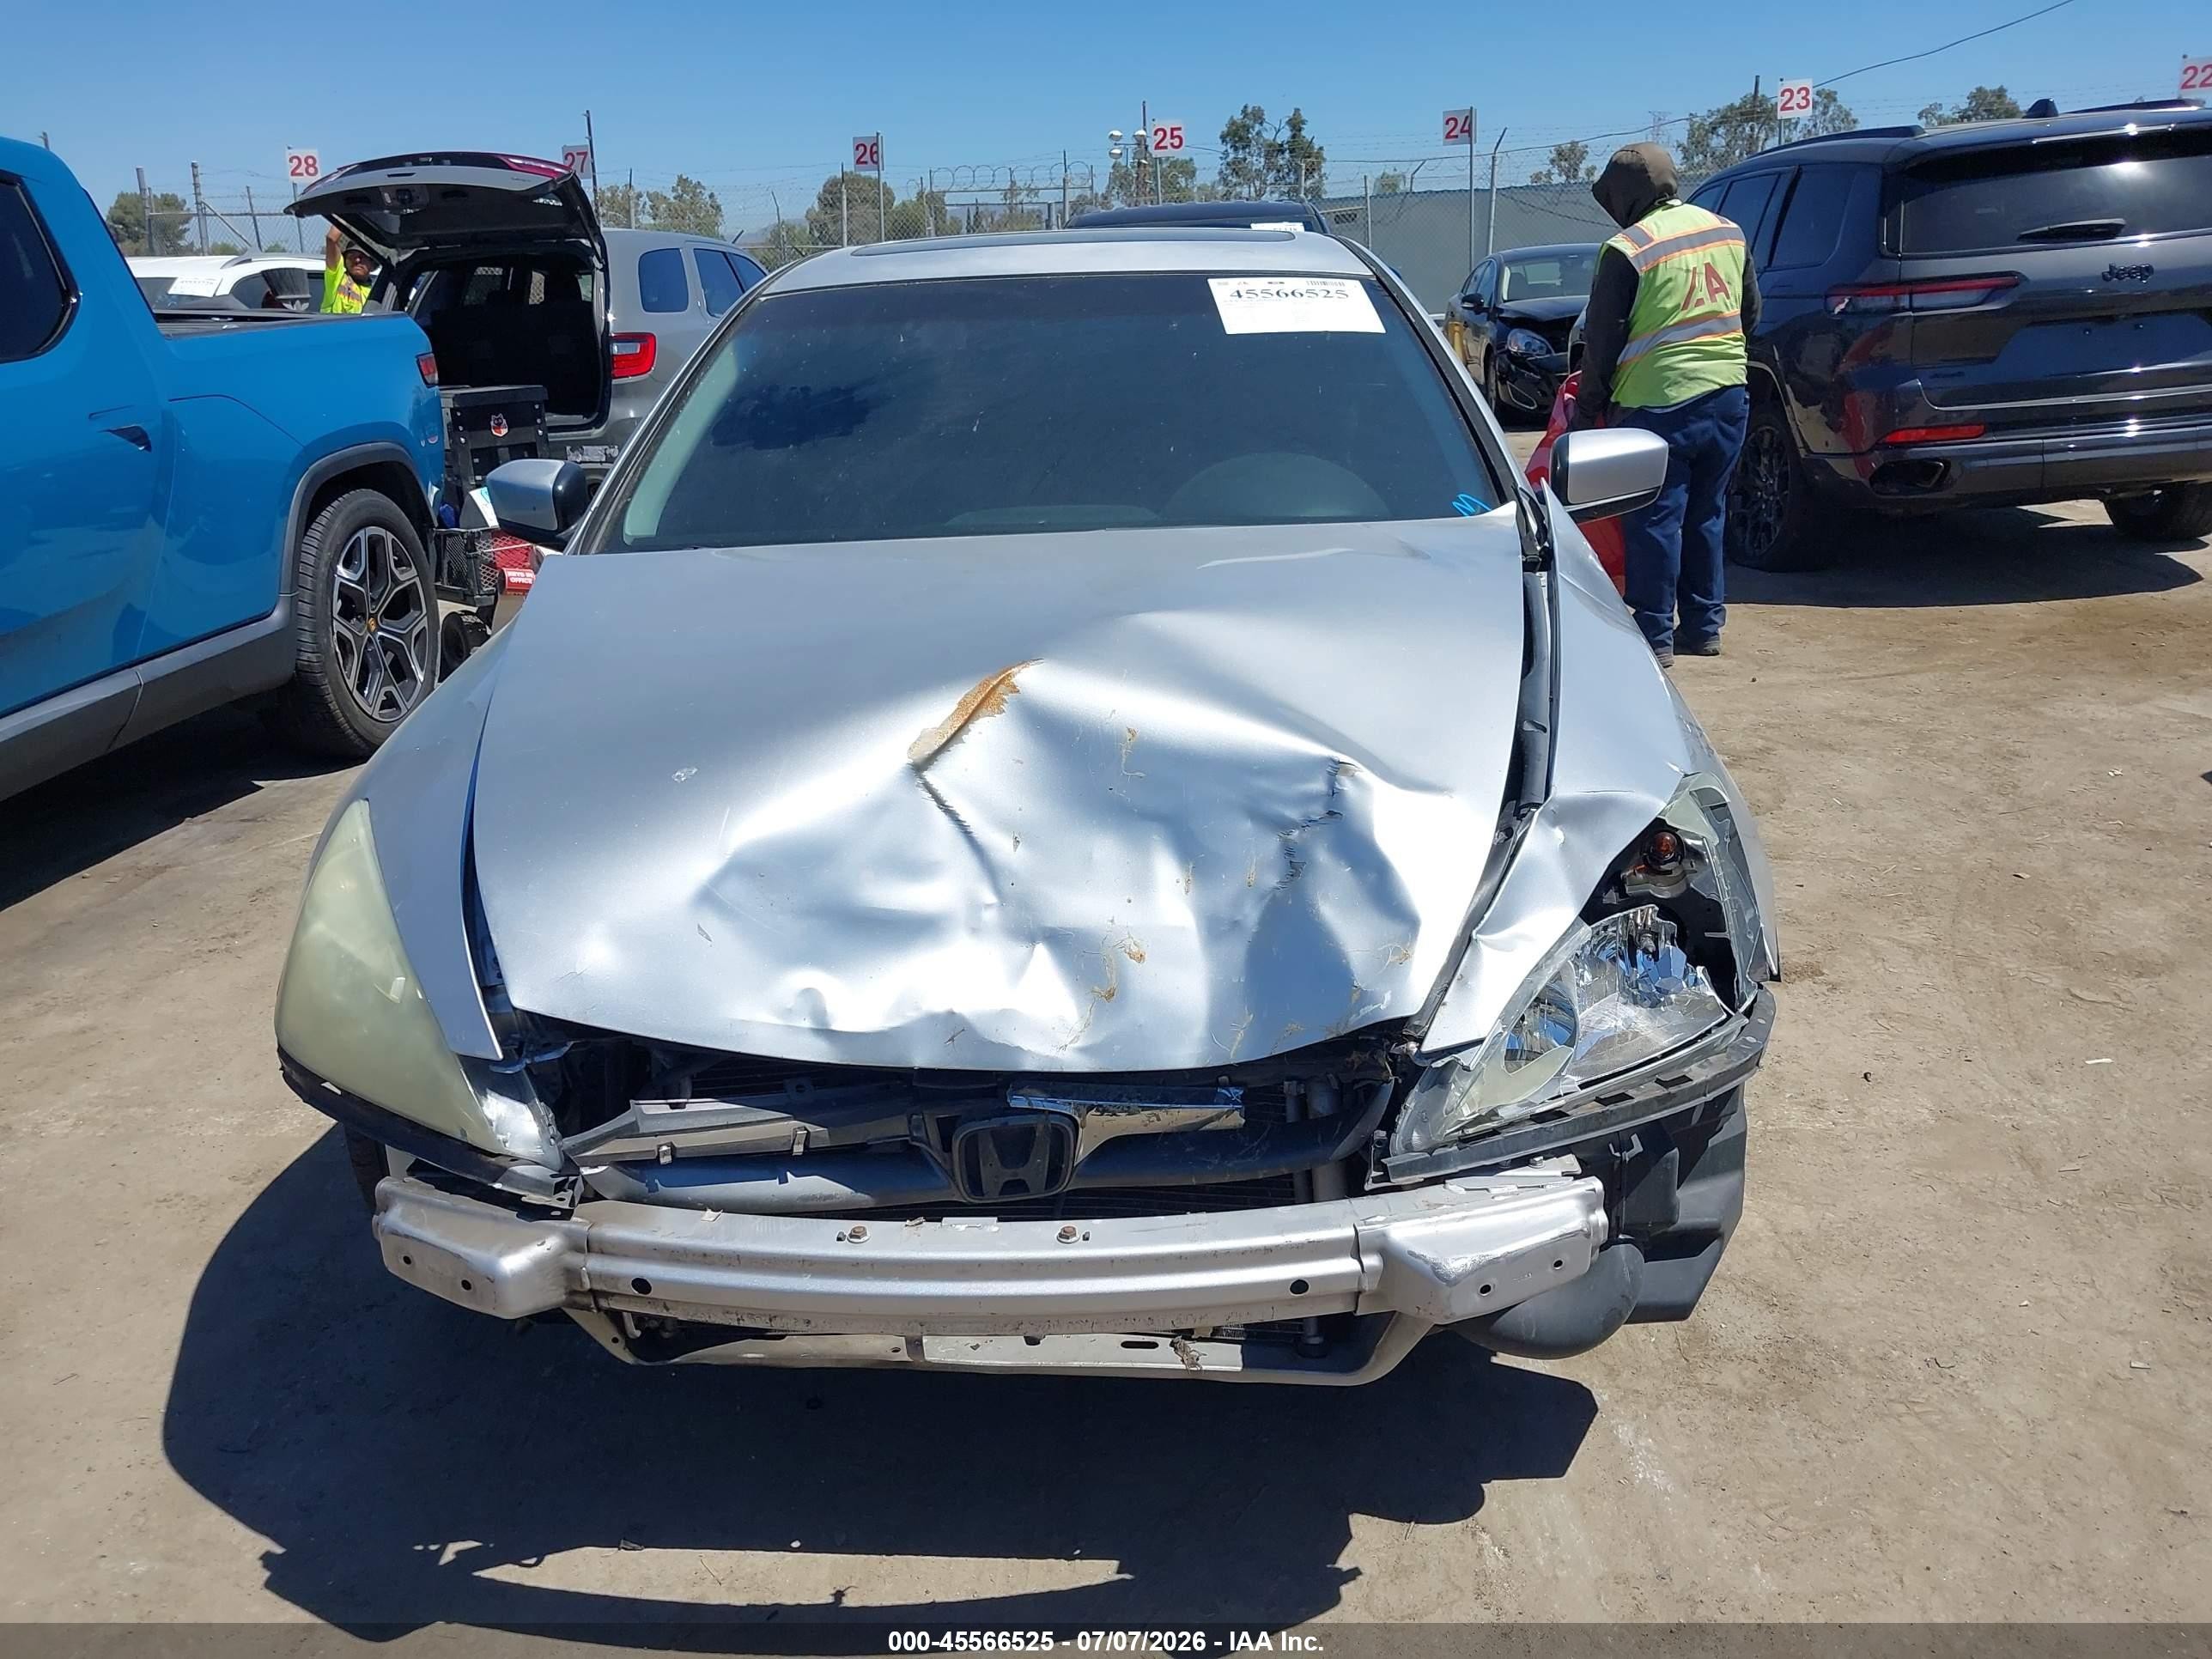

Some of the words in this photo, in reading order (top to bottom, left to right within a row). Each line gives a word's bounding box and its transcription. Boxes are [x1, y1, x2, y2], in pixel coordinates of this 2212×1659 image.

[2181, 64, 2212, 89] 22
[1780, 87, 1810, 111] 23
[1445, 115, 1472, 139] 24
[1153, 127, 1183, 150] 25
[565, 151, 588, 173] 27
[855, 143, 879, 165] 26
[289, 155, 319, 177] 28
[2102, 264, 2154, 284] Jeep
[1230, 289, 1349, 300] 45566525
